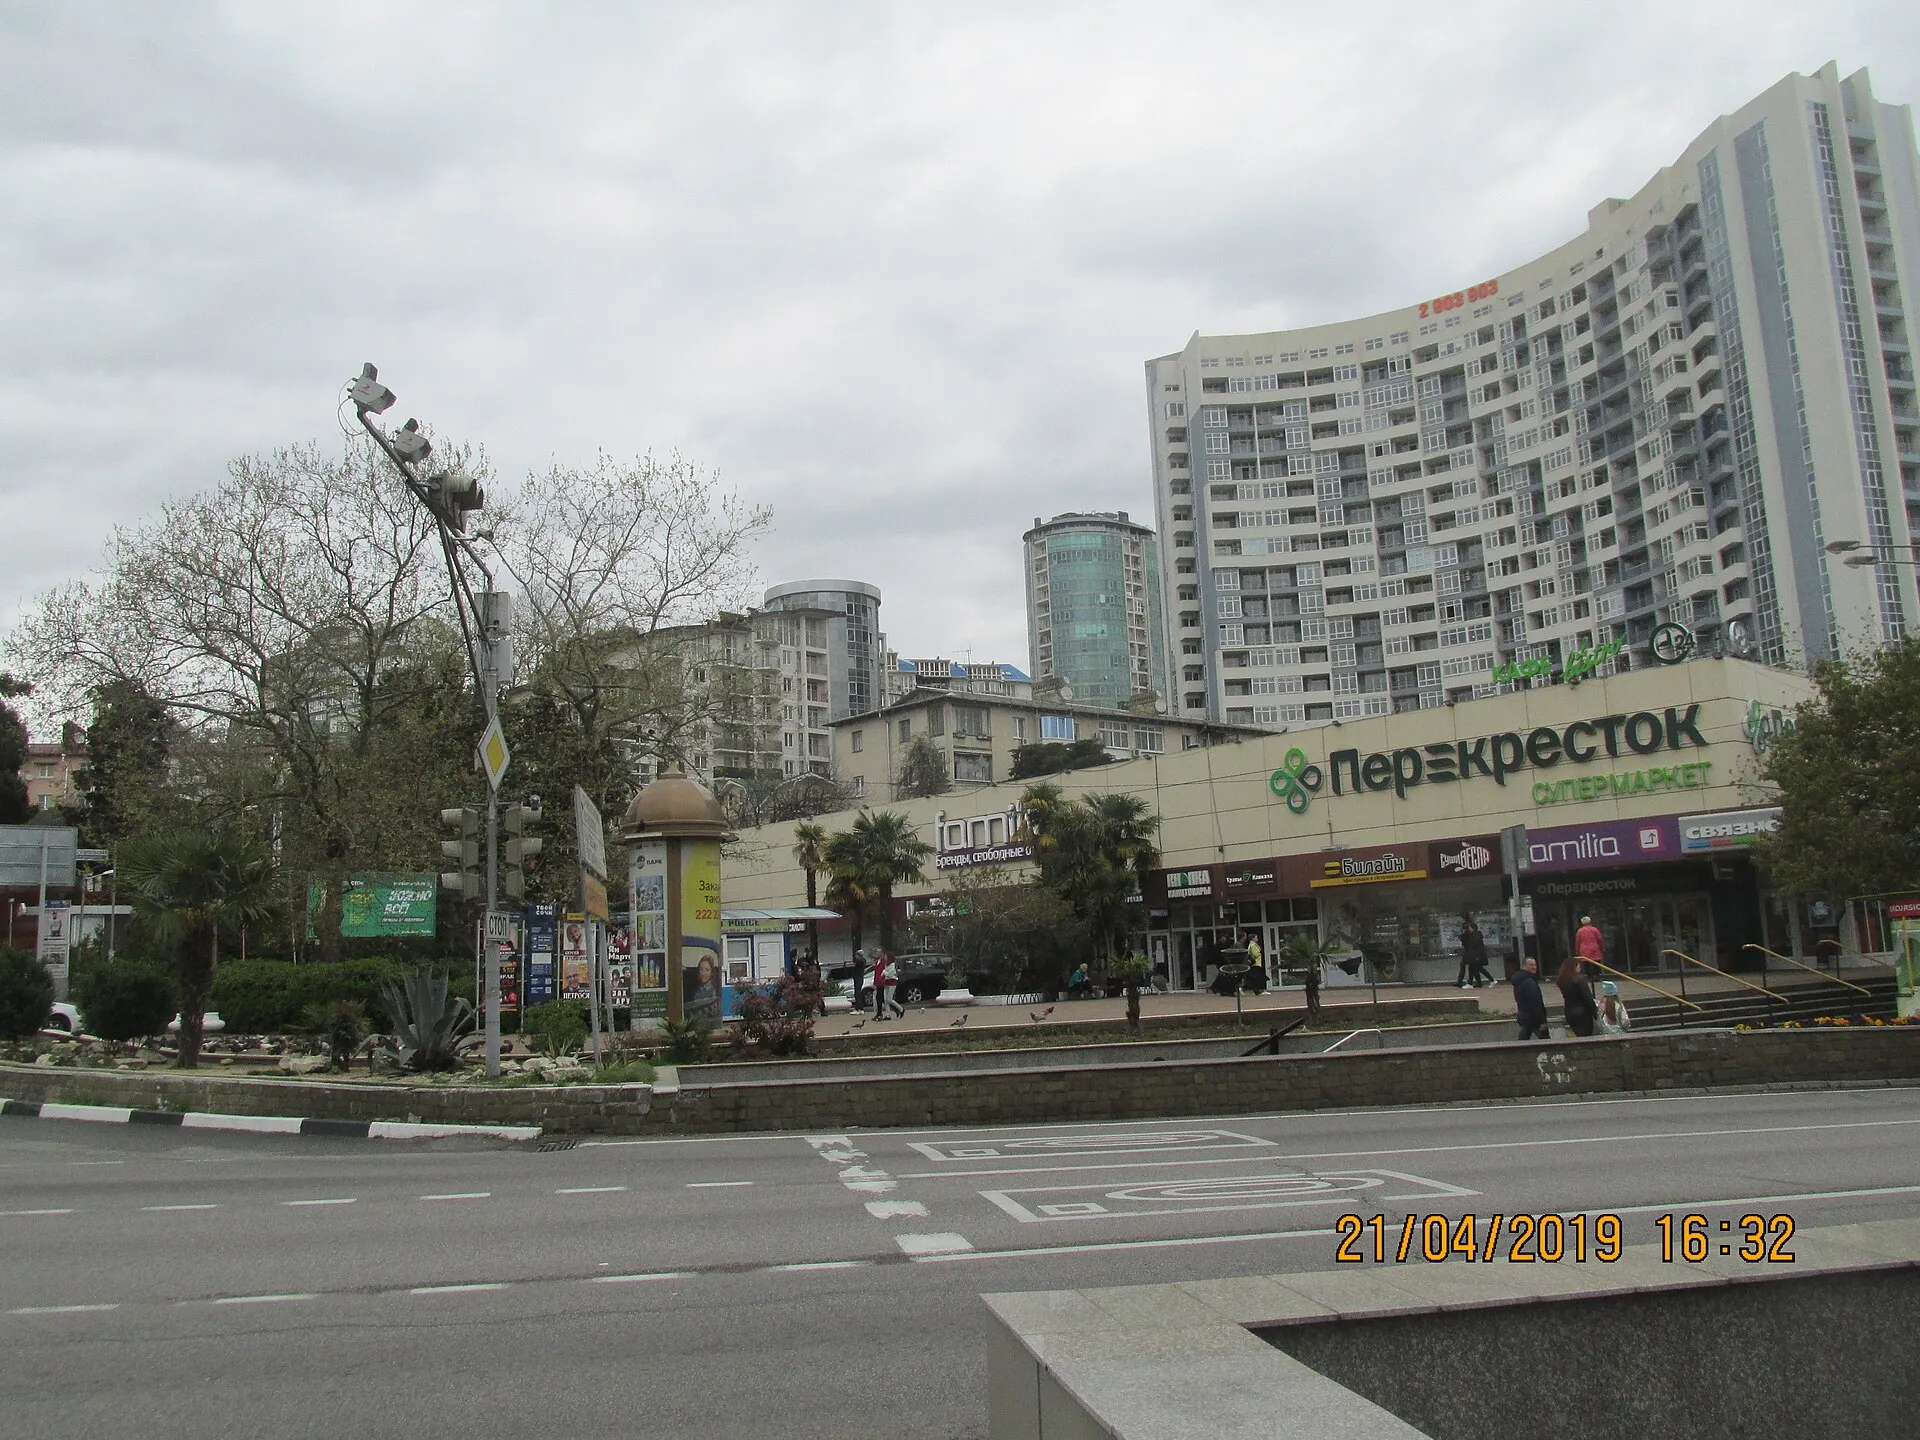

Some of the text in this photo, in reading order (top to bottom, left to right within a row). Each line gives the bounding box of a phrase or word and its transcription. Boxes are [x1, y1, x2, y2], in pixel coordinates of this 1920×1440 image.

[1418, 302, 1429, 319] 2
[1492, 655, 1552, 683] КАФЕ
[1330, 705, 1710, 798] Перекресток
[1531, 761, 1712, 804] СУПЕРМАРКЕТ
[1685, 818, 1782, 840] СВЯЗНО
[972, 846, 1023, 863] свободные
[1527, 832, 1620, 863] amilia
[1341, 854, 1405, 876] Билайн
[695, 909, 712, 919] 222
[489, 915, 507, 936] СТОП
